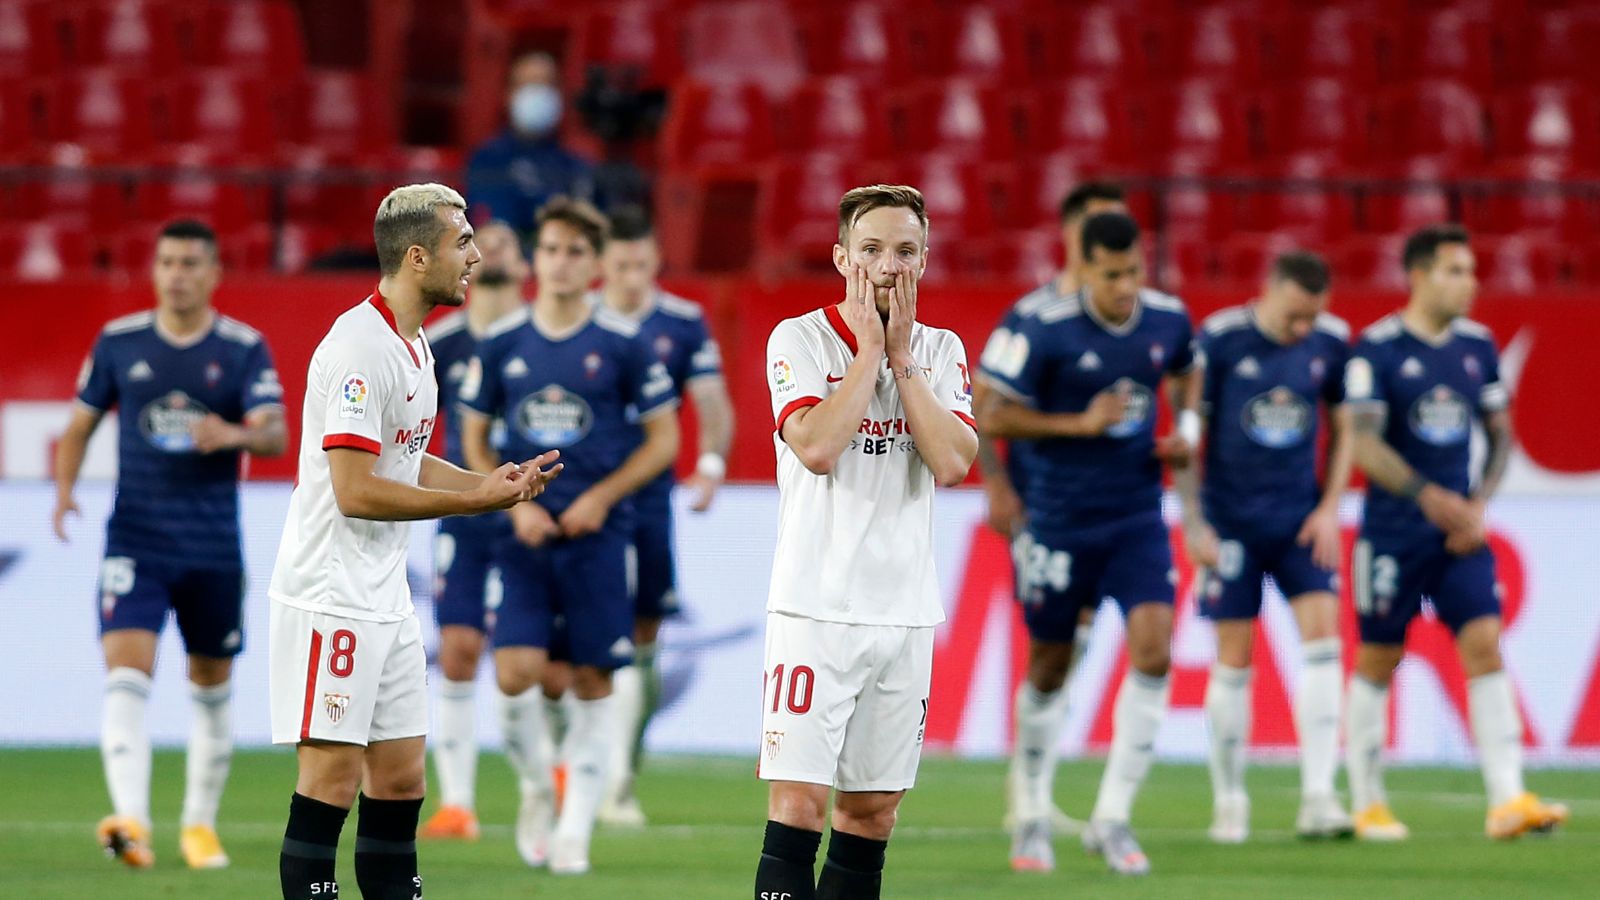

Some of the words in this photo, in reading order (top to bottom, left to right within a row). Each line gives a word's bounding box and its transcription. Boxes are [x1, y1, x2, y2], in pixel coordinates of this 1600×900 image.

[342, 405, 364, 414] LaLiga
[408, 434, 428, 455] BET
[862, 437, 896, 456] BET
[326, 629, 357, 679] 8
[768, 663, 816, 716] 10
